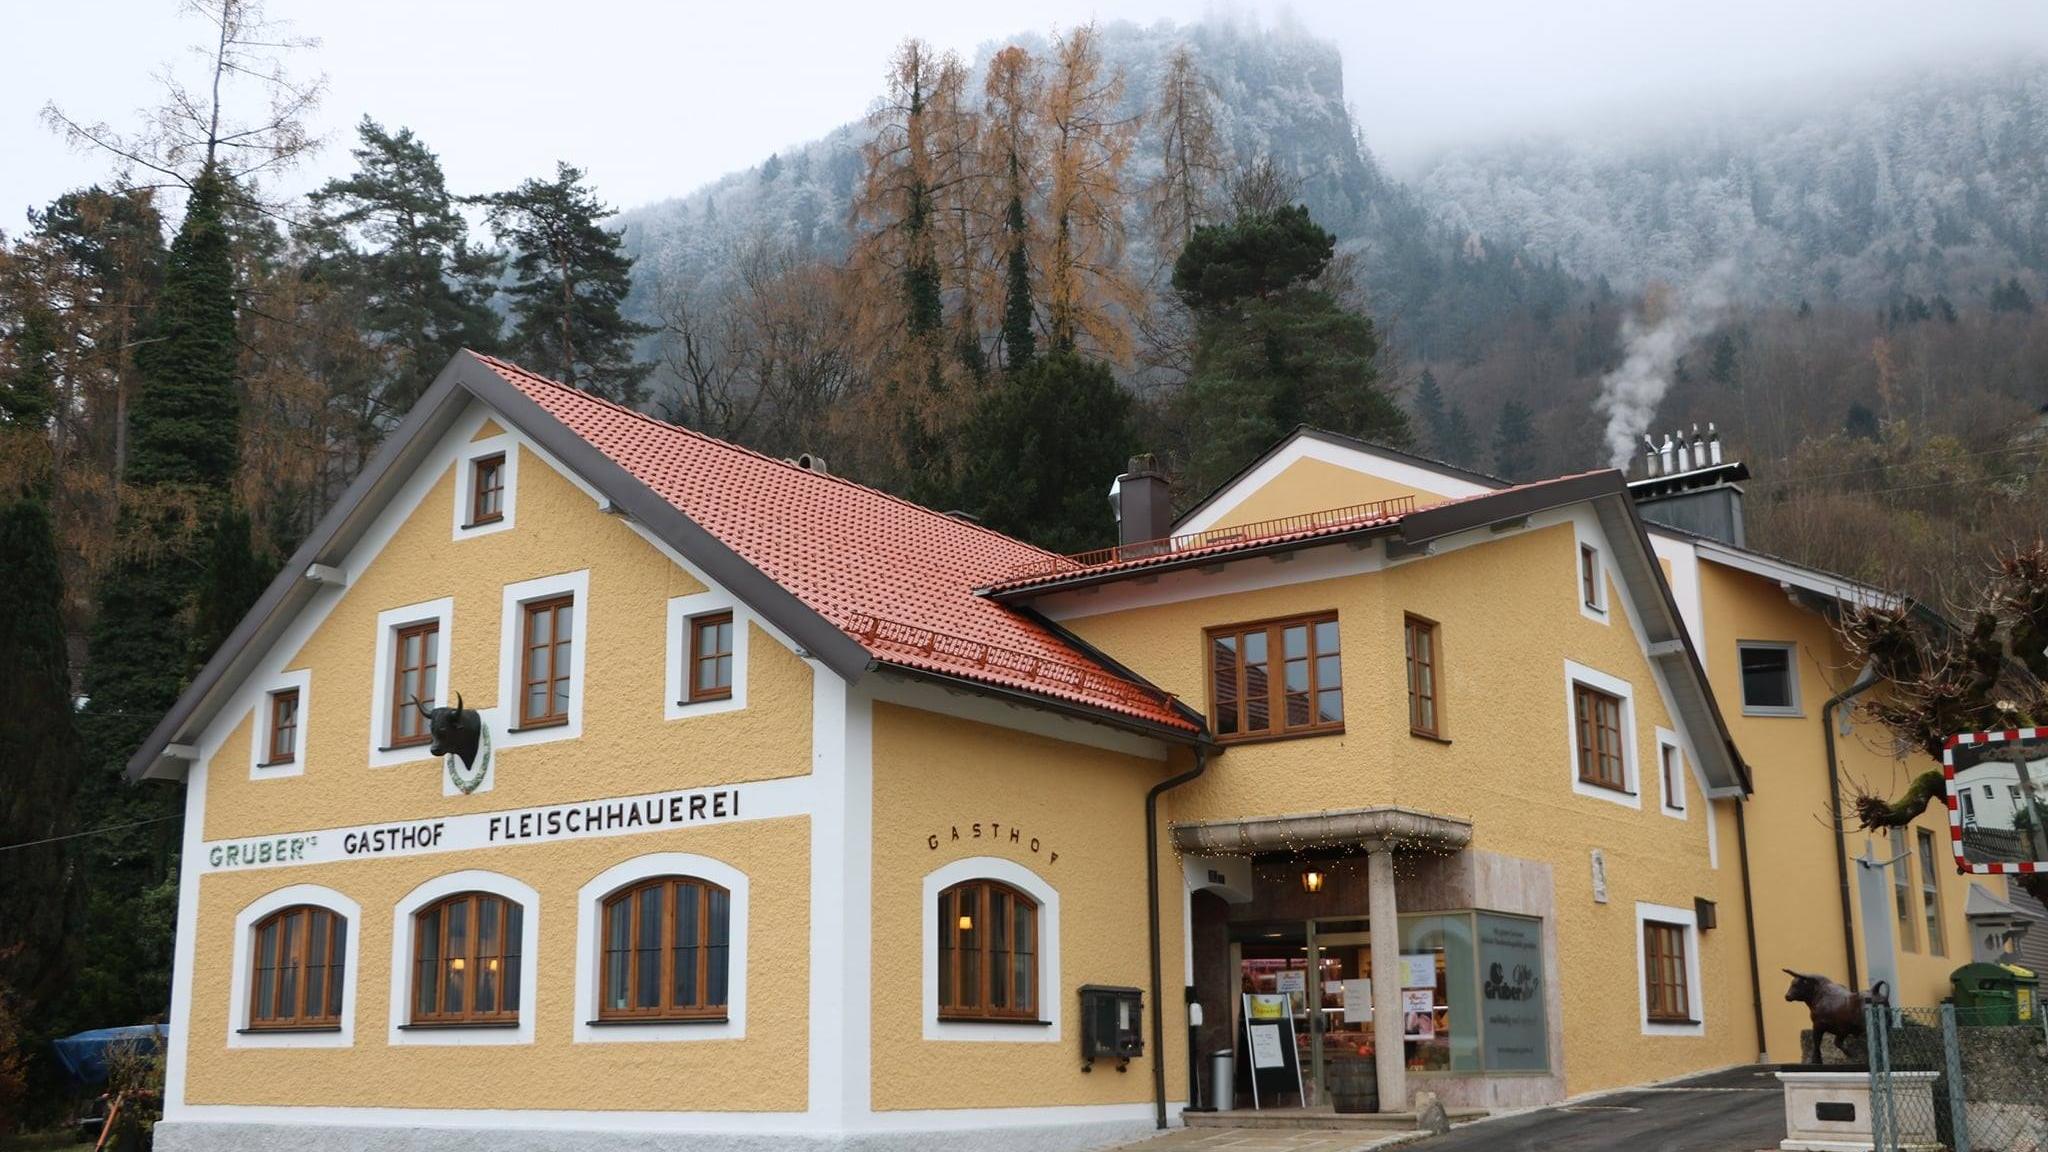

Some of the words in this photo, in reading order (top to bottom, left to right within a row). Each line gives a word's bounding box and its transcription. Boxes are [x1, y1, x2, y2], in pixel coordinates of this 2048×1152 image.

[344, 823, 445, 855] GASTHOF
[489, 790, 739, 841] FLEISCHHAUEREI
[927, 823, 1059, 865] GASTHOF
